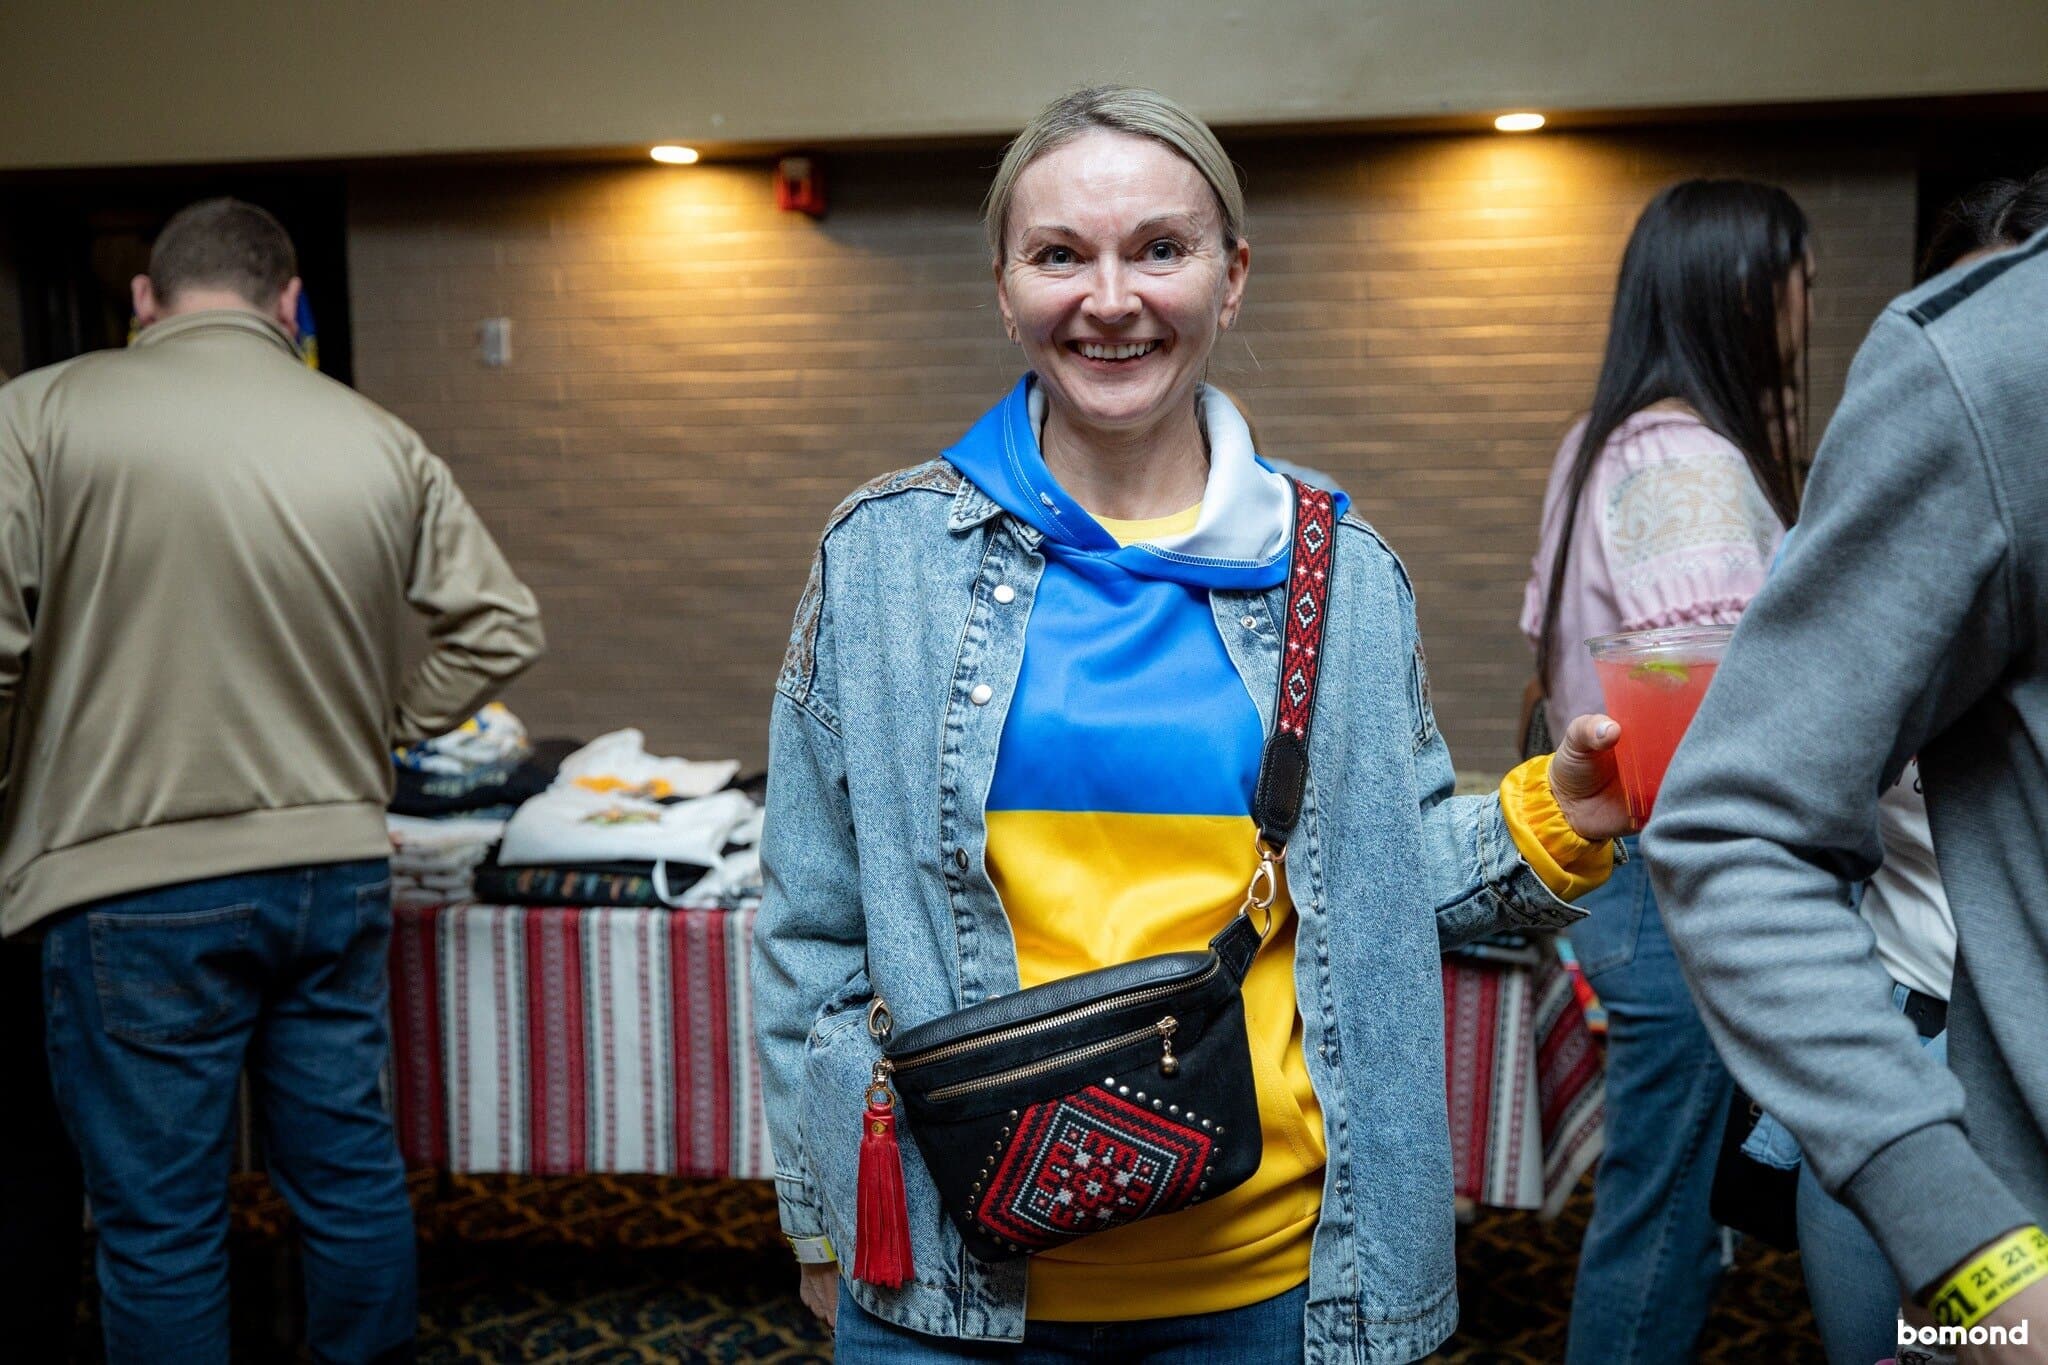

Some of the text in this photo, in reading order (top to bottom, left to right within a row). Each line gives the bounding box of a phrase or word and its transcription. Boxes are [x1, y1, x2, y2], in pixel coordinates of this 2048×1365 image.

[1971, 1265, 1995, 1288] 21
[2001, 1245, 2027, 1267] 21
[1935, 1284, 1978, 1328] 21
